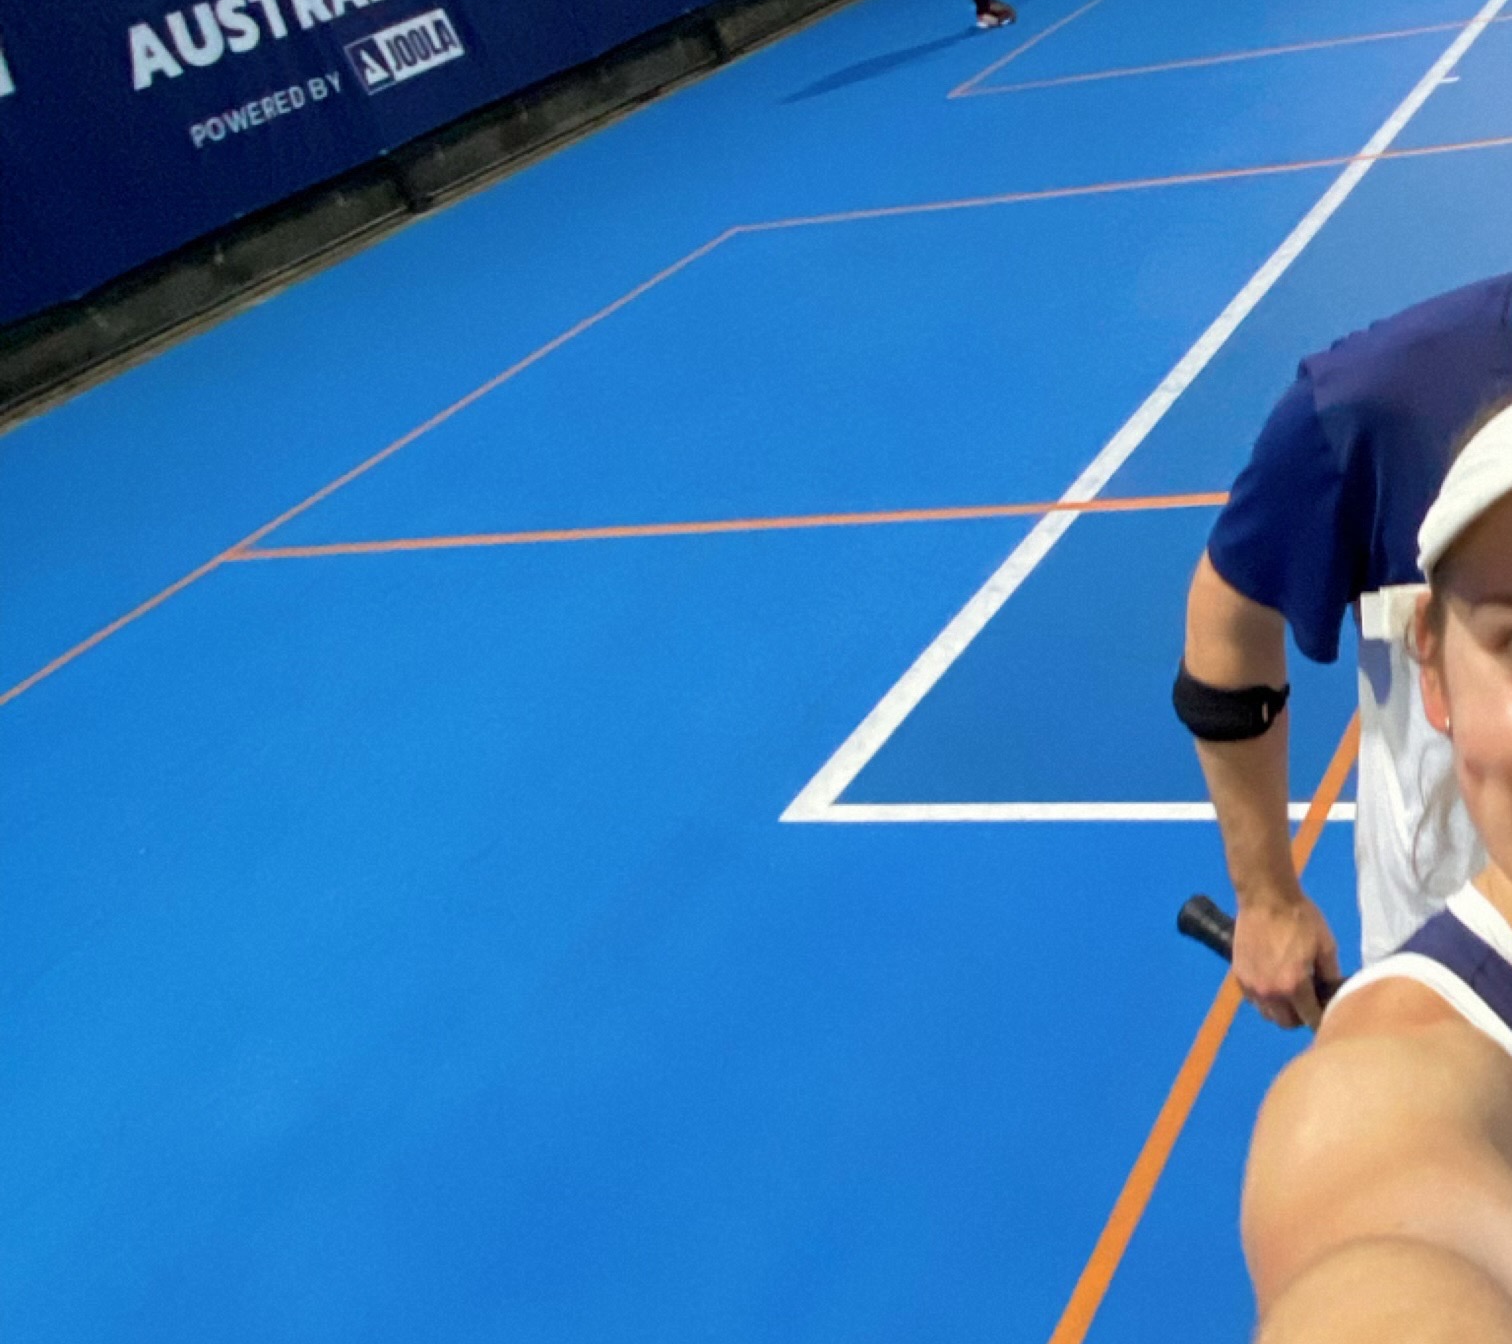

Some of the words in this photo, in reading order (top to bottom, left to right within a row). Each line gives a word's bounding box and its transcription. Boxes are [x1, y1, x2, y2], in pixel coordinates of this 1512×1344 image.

[189, 86, 305, 149] POWERED
[307, 70, 344, 100] BY
[384, 19, 459, 72] JOOLA
